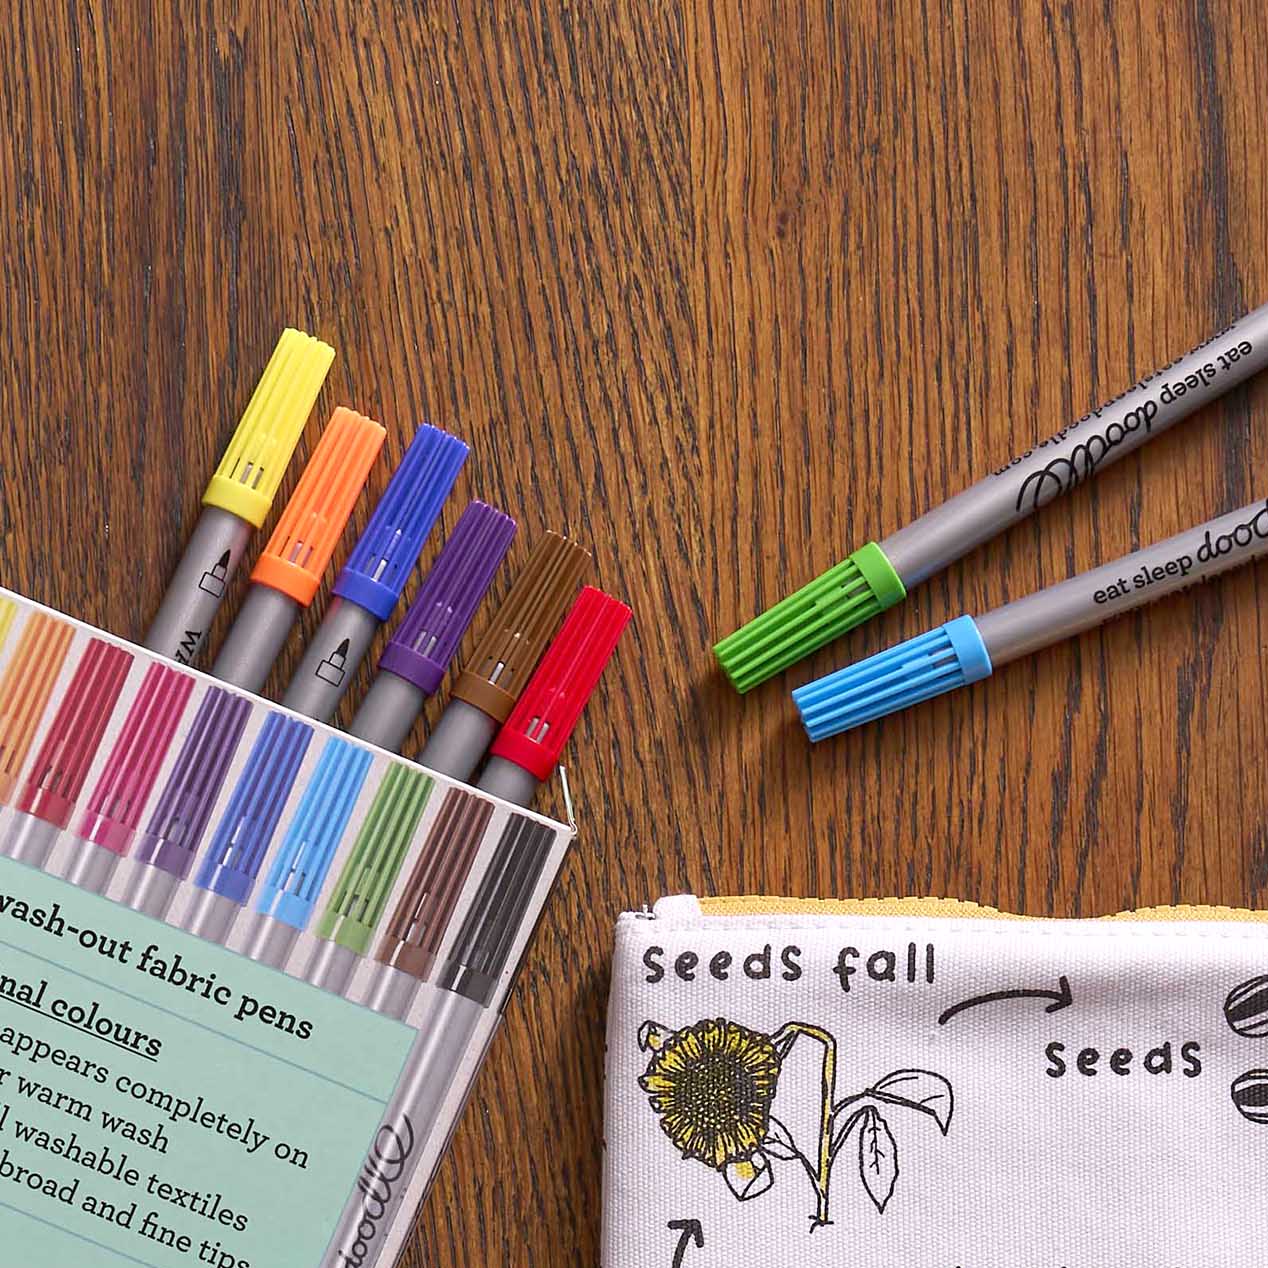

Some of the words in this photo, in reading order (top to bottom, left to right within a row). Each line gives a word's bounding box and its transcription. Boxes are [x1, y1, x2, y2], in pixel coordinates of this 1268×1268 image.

[1160, 363, 1217, 405] sleep
[1218, 341, 1252, 370] eat
[1016, 400, 1158, 513] doodle
[1093, 579, 1131, 604] eat
[1132, 554, 1193, 590] sleep
[136, 944, 232, 1006] fabric
[233, 994, 314, 1040] pens
[642, 943, 803, 984] seeds
[832, 942, 935, 993] fall
[50, 1002, 162, 1057] colours
[1045, 1041, 1202, 1079] seeds
[18, 1076, 93, 1122] warm
[101, 1111, 169, 1154] wash
[115, 1076, 270, 1153] completely
[274, 1143, 309, 1169] on
[0, 1149, 80, 1205] broad
[81, 1191, 138, 1230] and
[138, 1211, 192, 1253] fine
[15, 1120, 140, 1186] washable
[146, 1174, 249, 1232] textiles
